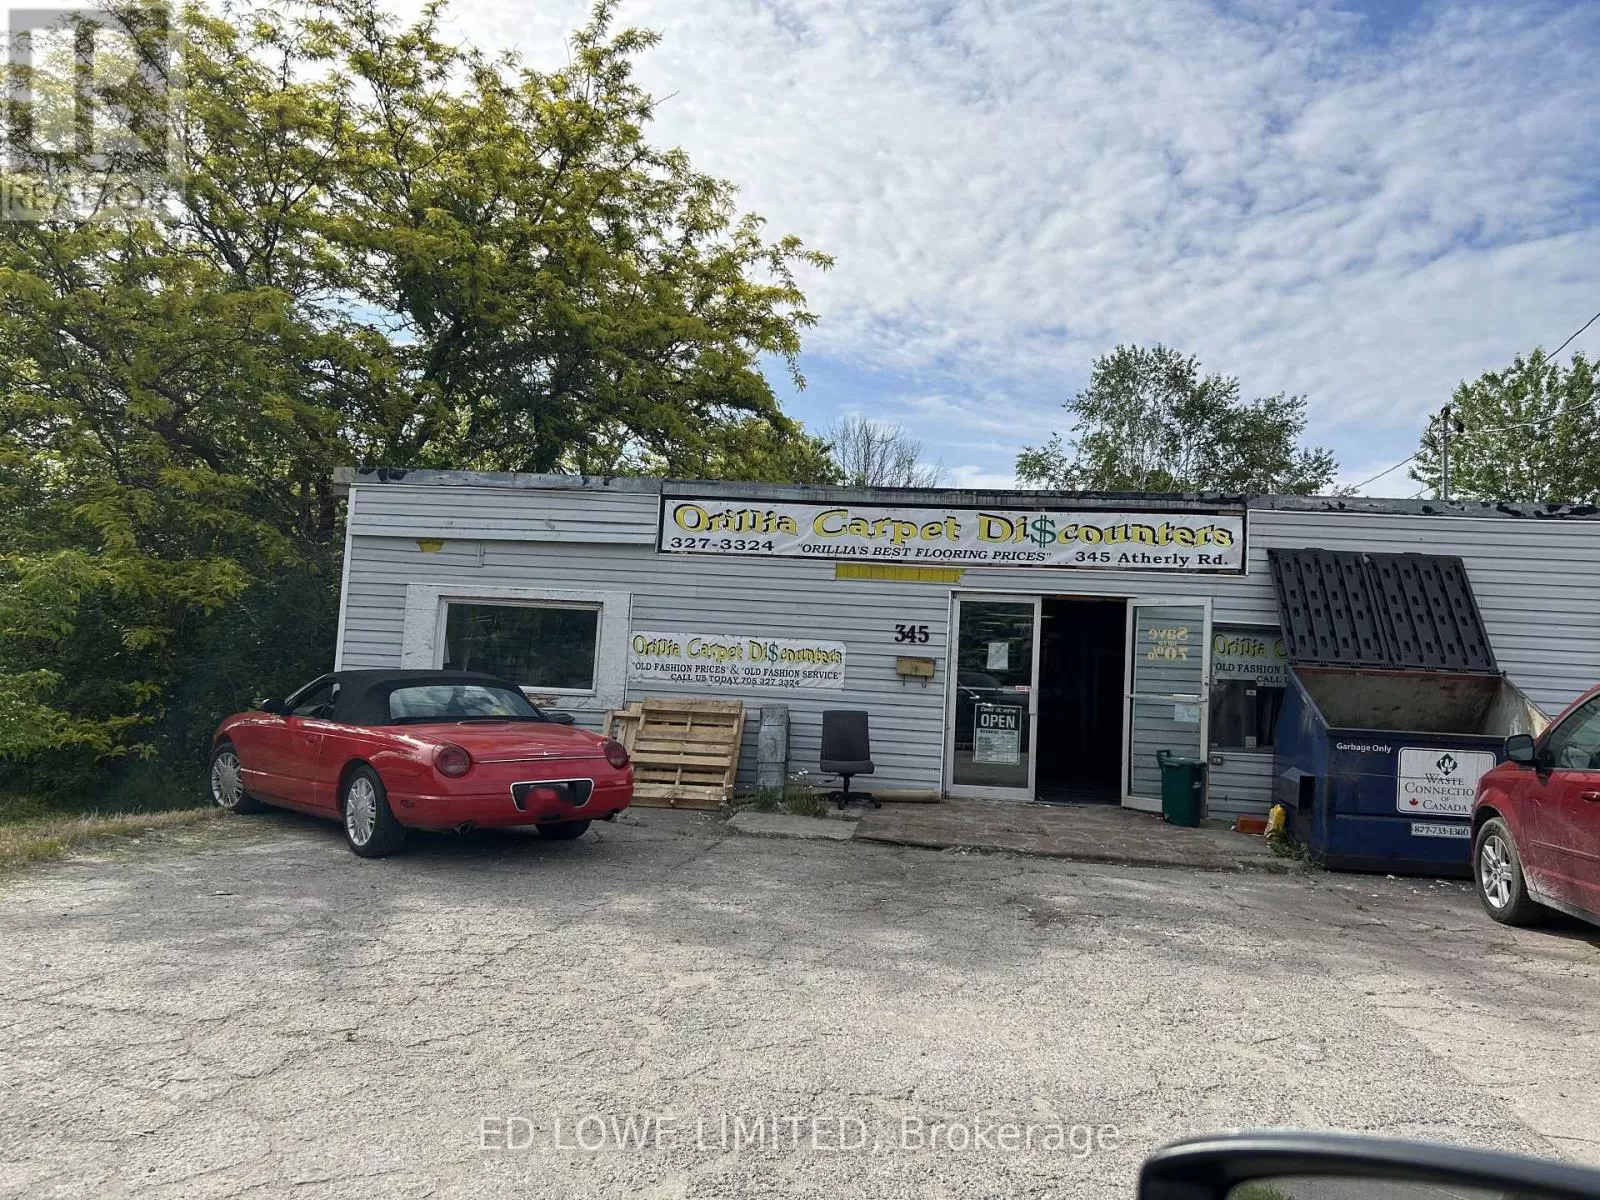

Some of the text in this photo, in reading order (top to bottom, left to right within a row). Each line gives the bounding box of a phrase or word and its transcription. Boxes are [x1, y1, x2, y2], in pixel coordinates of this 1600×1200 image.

[673, 503, 1234, 548] Orillia Carpet Di$counters
[670, 537, 775, 551] 327-3324
[797, 543, 1052, 562] "ORILLIA'S BEST FLOORING PRICES"
[1075, 551, 1228, 567] 345 Atherly Rd.
[894, 624, 930, 643] 345
[633, 635, 681, 657] Orillia
[687, 638, 743, 663] Carpet
[1213, 634, 1267, 657] Orillia
[654, 663, 693, 673] FASHION
[730, 664, 739, 674] &
[763, 668, 800, 678] FASHION
[1237, 664, 1280, 673] FASHION
[671, 673, 693, 681] CALL
[695, 674, 707, 682] US
[760, 678, 775, 686] 327
[778, 679, 800, 687] 3324
[1256, 675, 1280, 683] CALL
[980, 713, 1015, 729] OPEN
[1336, 742, 1392, 754] Garbage Only
[1424, 772, 1465, 786] WASTE
[1405, 782, 1475, 797] CONNECTIO
[1423, 799, 1468, 812] CANADA
